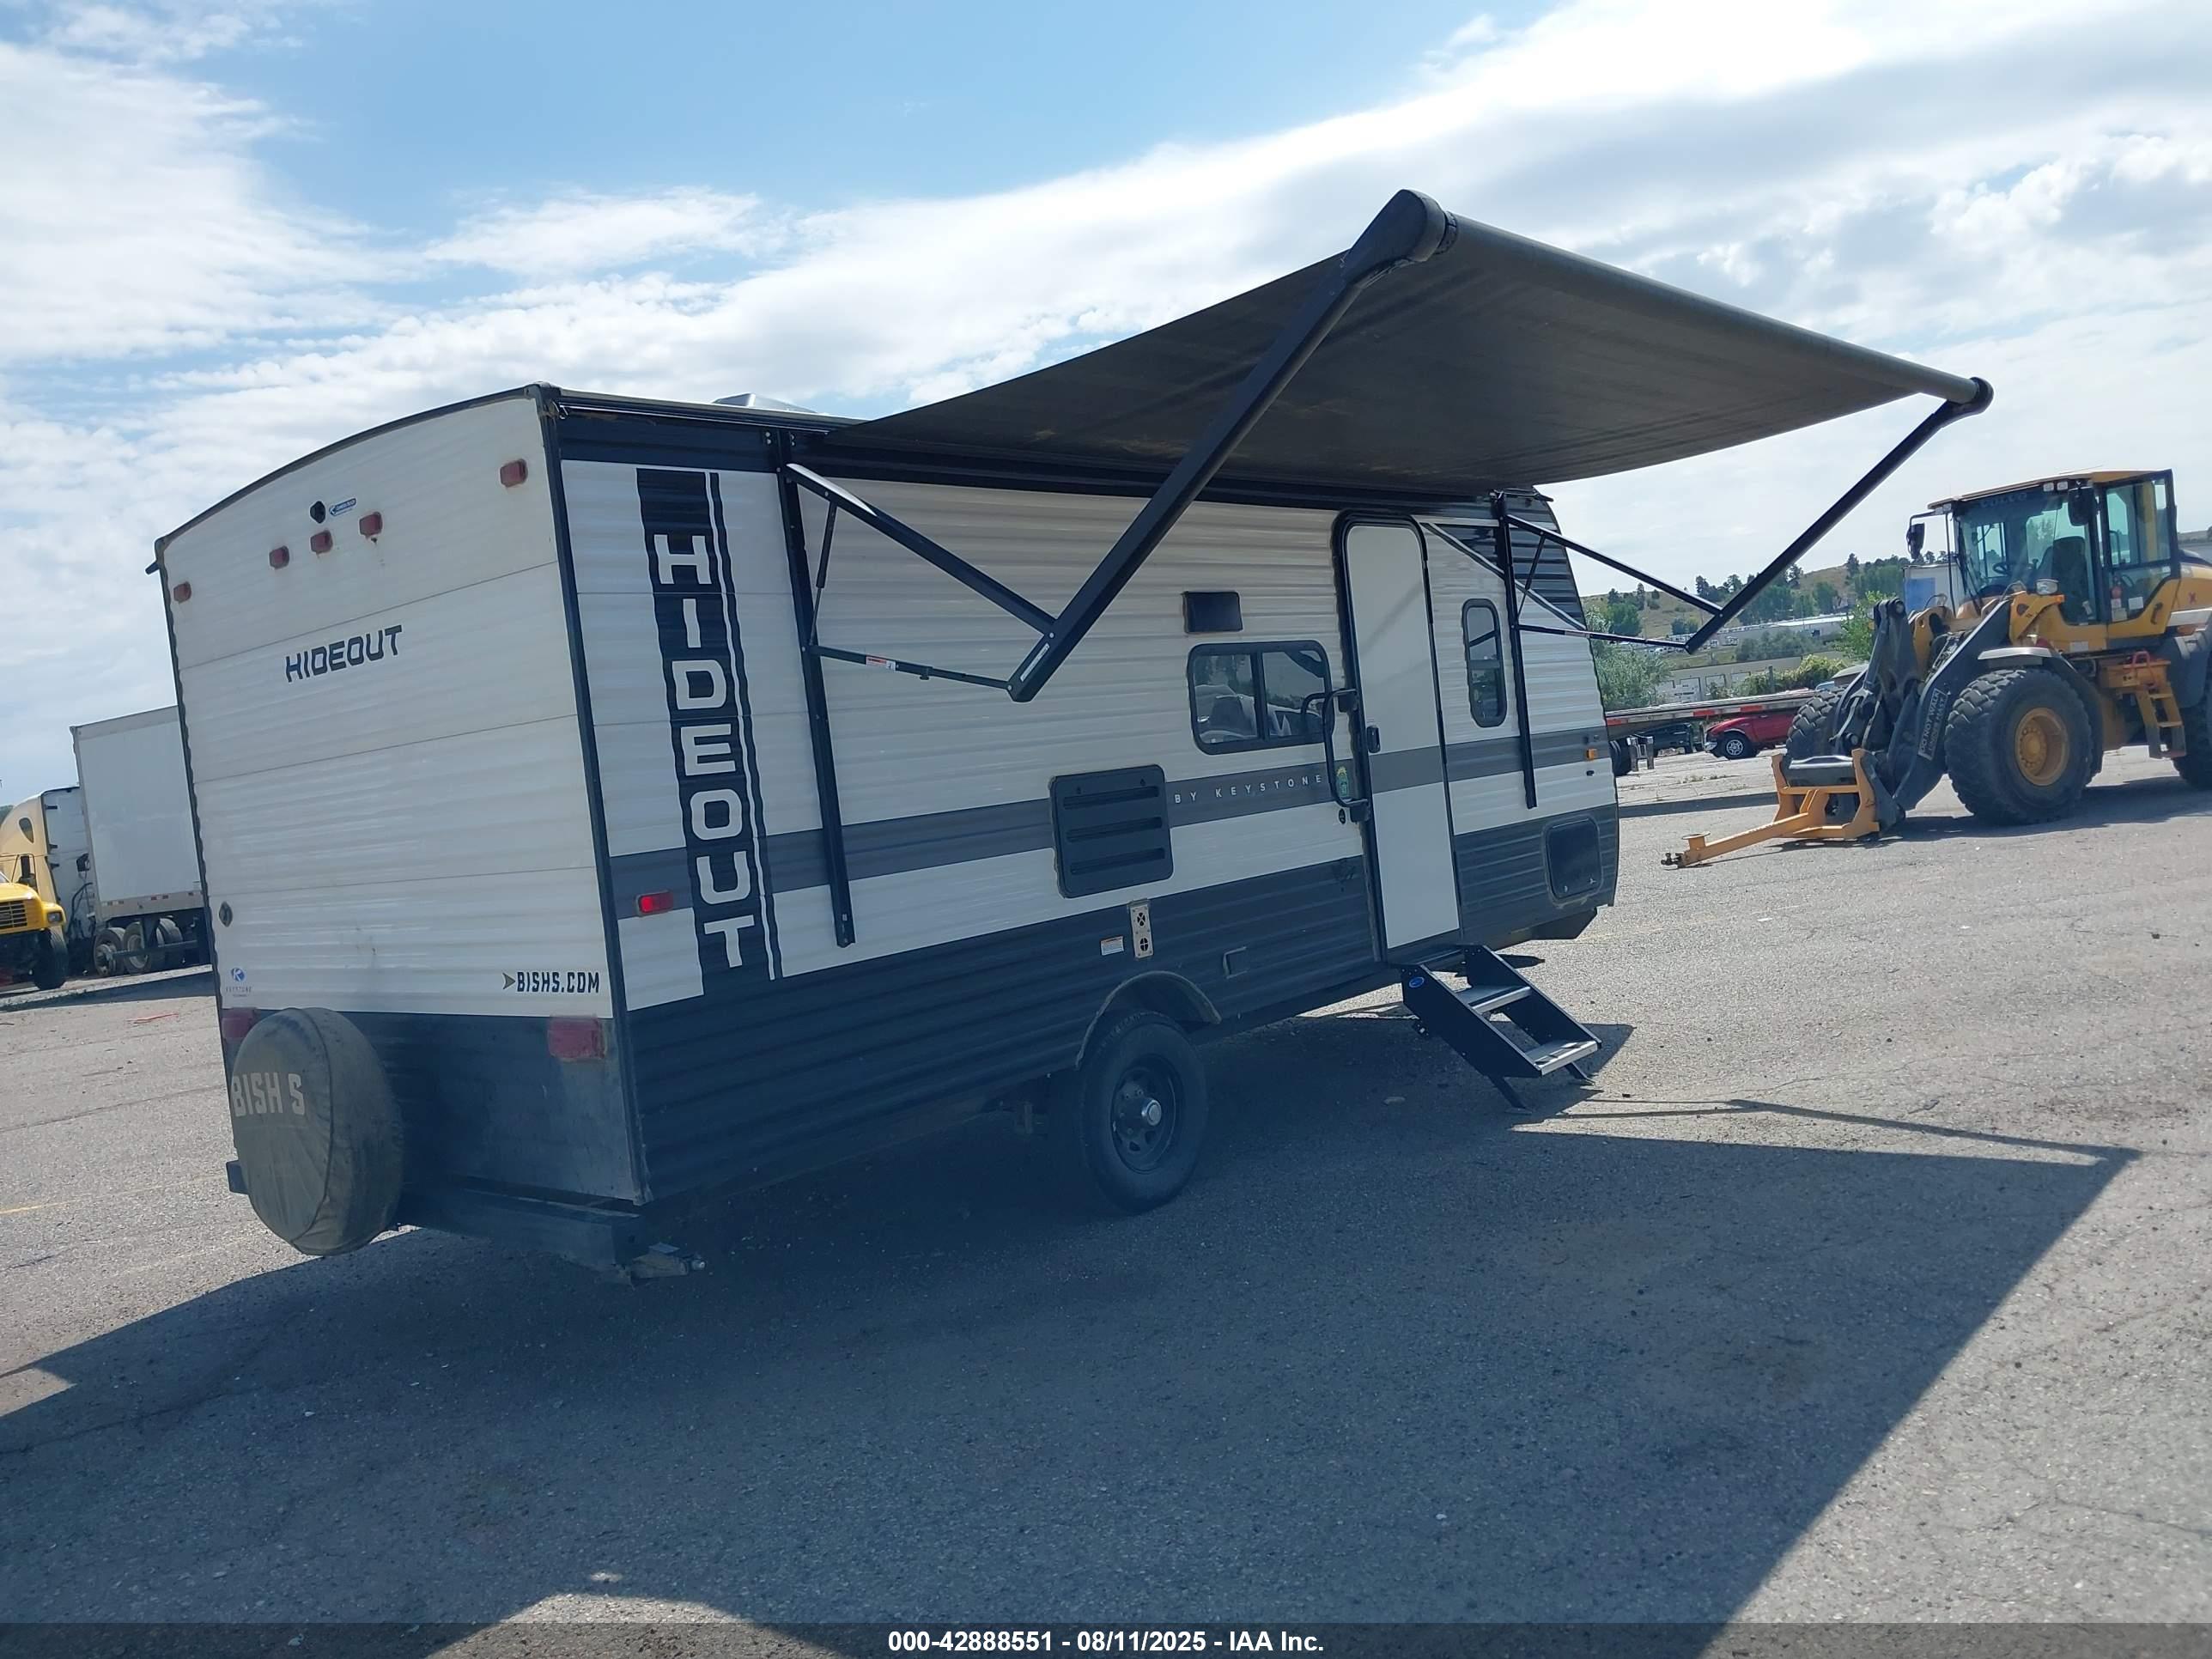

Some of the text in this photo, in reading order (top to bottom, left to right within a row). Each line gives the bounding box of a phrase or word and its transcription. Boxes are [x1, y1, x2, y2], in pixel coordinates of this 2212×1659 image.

[286, 624, 403, 683] HIDEOUT
[653, 534, 755, 968] HIDEOUT
[1174, 792, 1197, 804] BY
[1215, 775, 1322, 798] KEYSTONE
[517, 971, 600, 994] BISHS.COM
